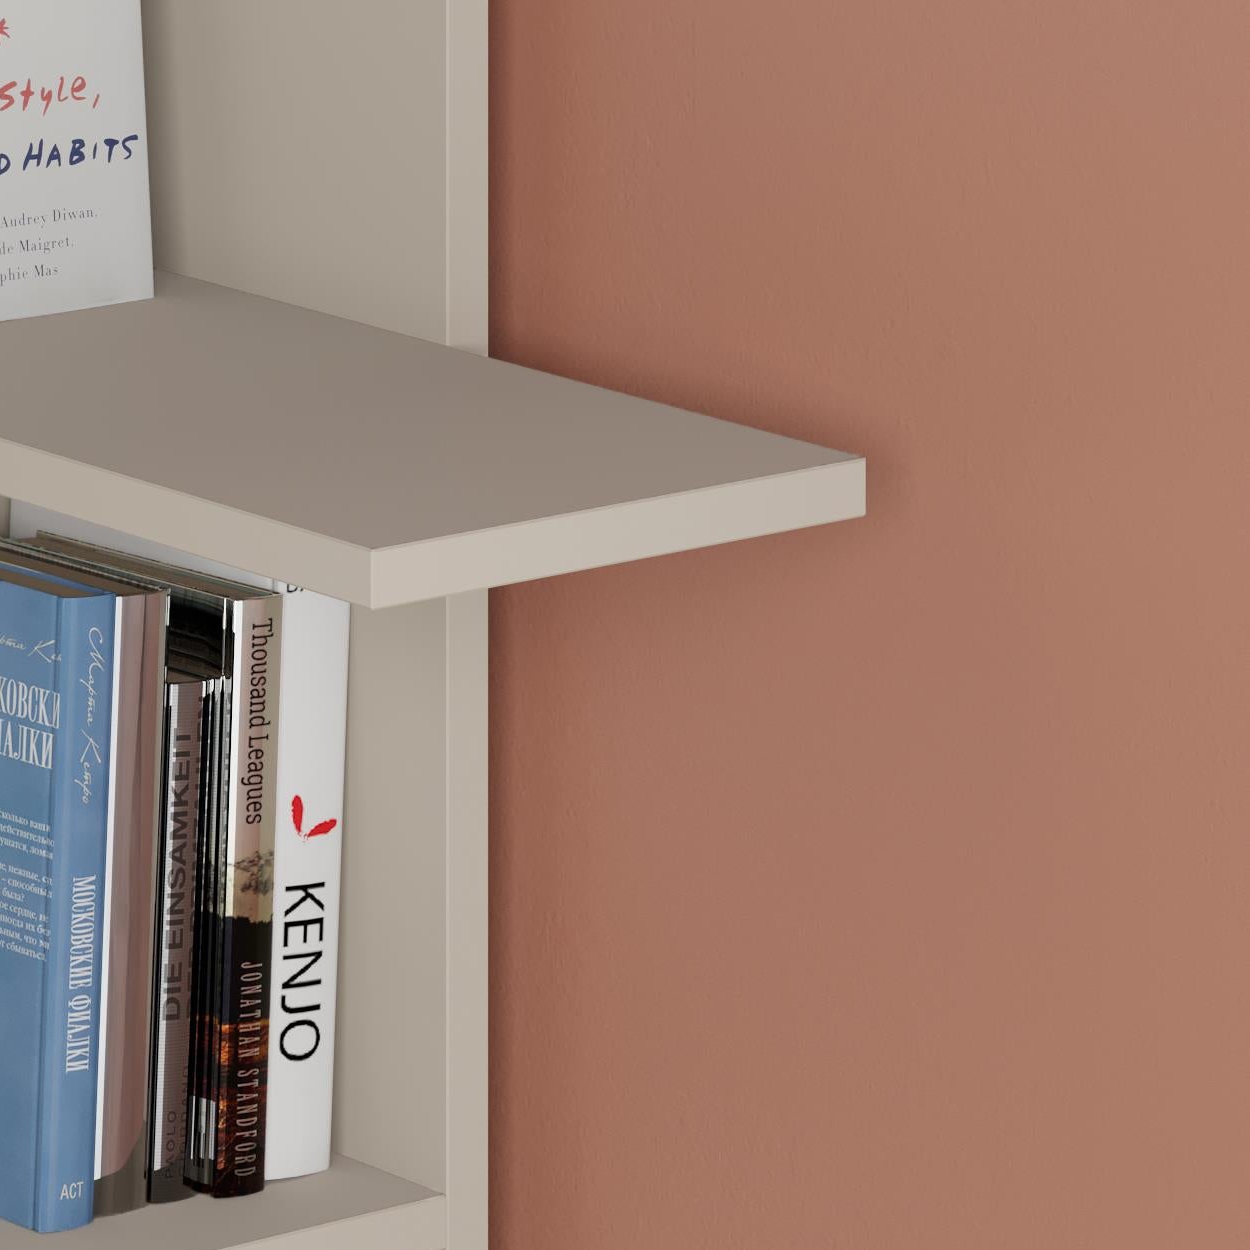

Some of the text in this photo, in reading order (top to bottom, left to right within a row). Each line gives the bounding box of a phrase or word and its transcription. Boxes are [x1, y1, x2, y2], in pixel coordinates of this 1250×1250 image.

[23, 134, 138, 171] HABITS
[0, 212, 48, 229] Audrey
[34, 263, 60, 279] Mas
[241, 618, 274, 825] Thousand Leagues
[66, 875, 97, 1073] МОСКОВСКИЕ ФИАЛКИ
[163, 962, 183, 1021] DIE
[279, 881, 326, 1062] KENJO
[234, 961, 263, 1177] JONATHAN STANDFORD
